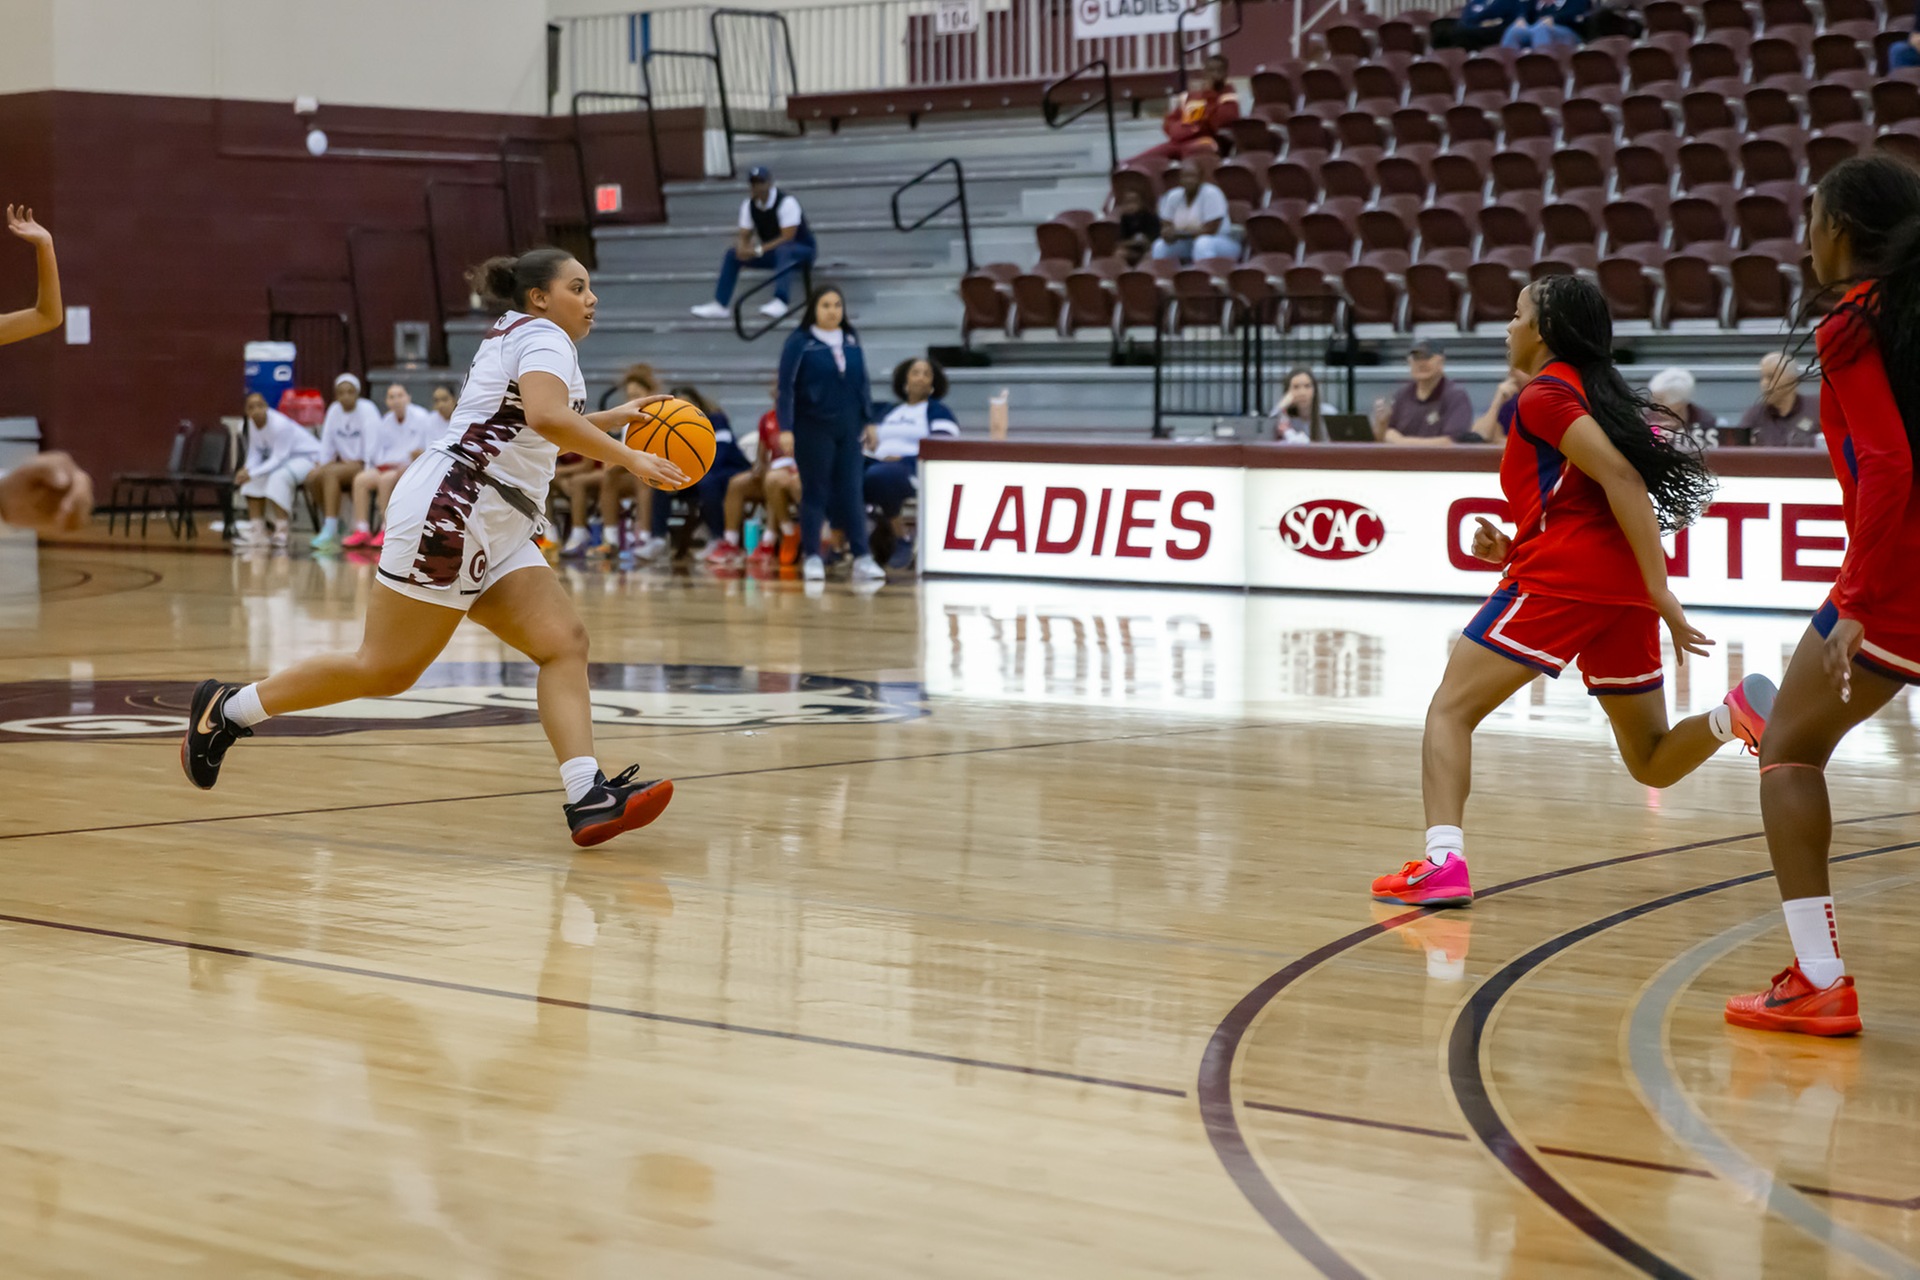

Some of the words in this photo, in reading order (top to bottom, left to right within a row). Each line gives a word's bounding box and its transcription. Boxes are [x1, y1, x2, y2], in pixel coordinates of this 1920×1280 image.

[1106, 0, 1180, 17] LADIES
[943, 484, 1215, 560] LADIES
[1282, 504, 1380, 555] SCAC
